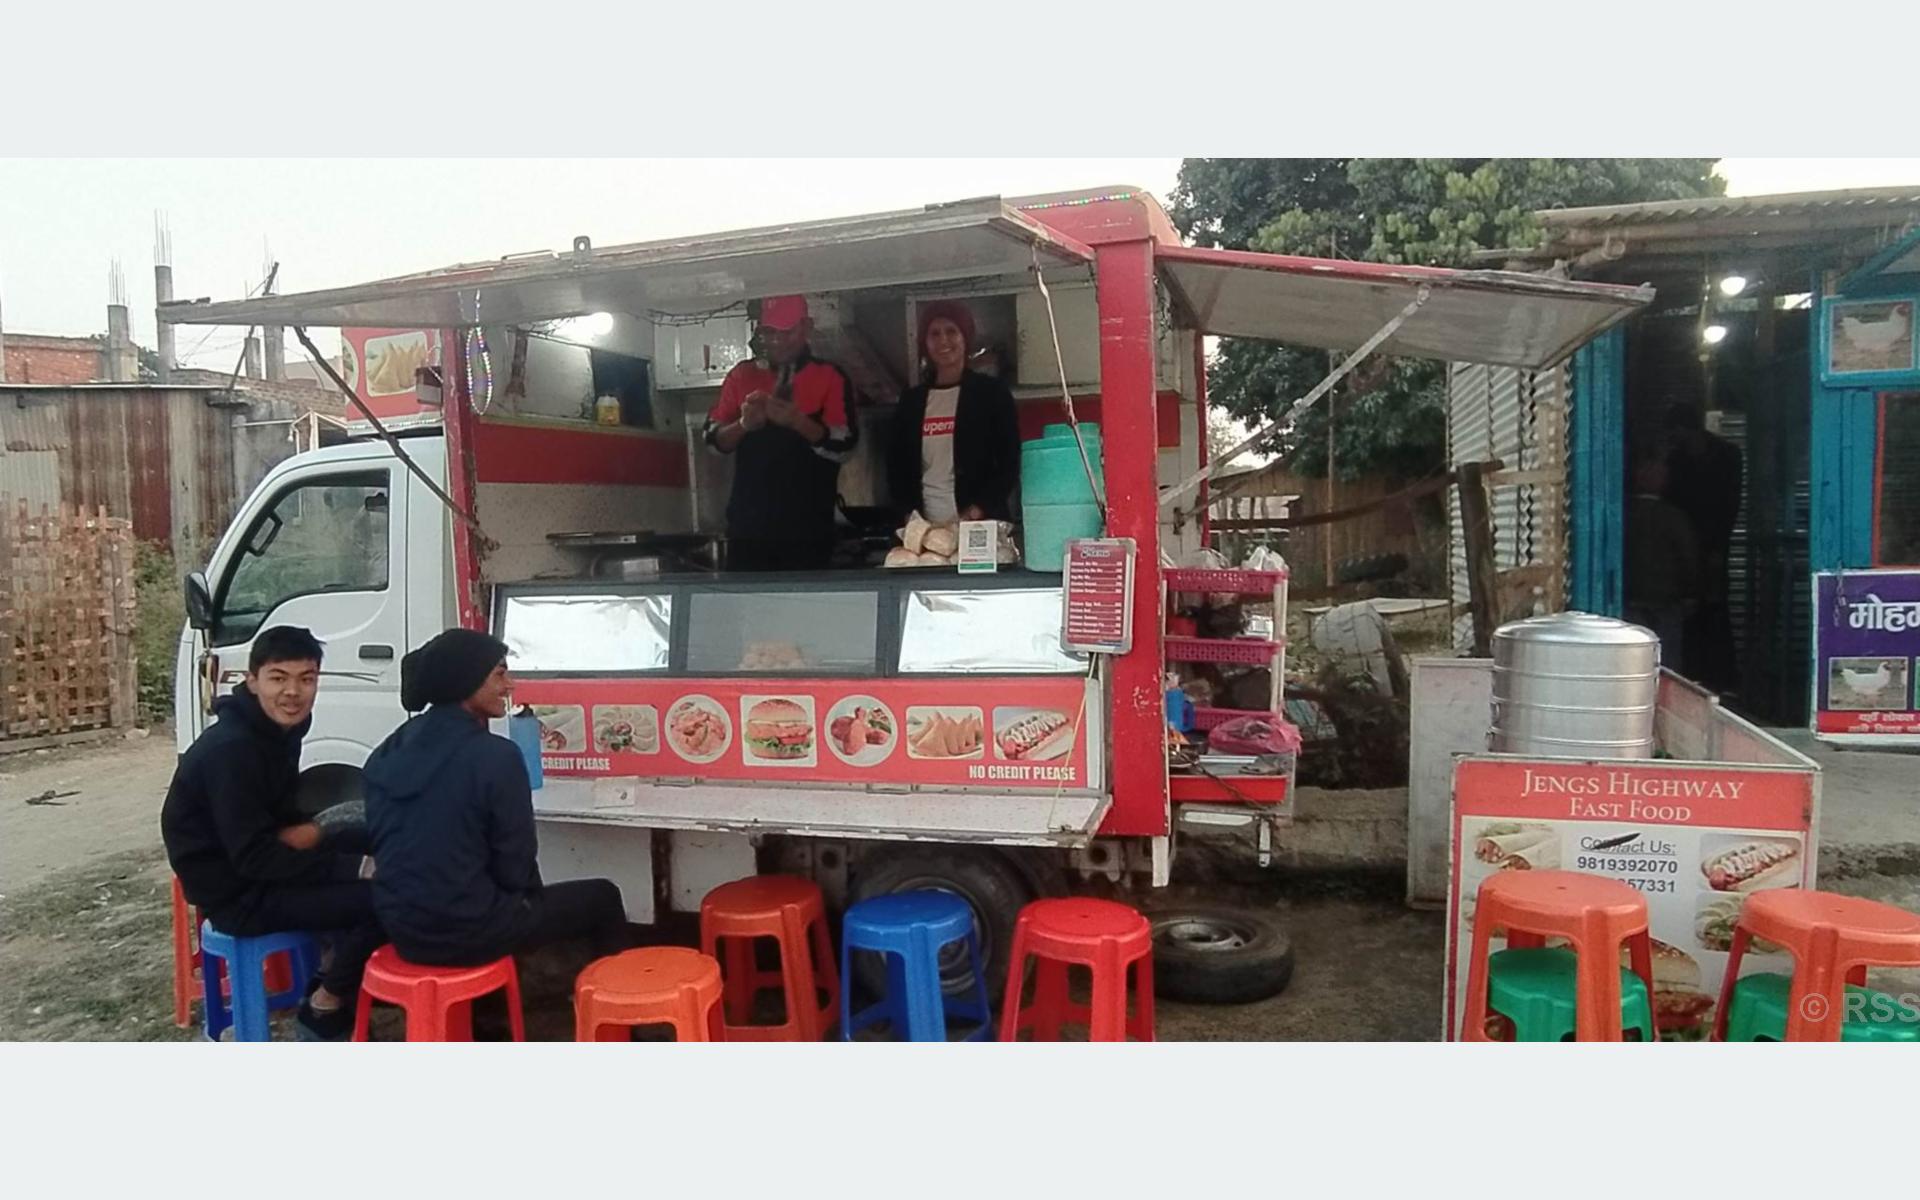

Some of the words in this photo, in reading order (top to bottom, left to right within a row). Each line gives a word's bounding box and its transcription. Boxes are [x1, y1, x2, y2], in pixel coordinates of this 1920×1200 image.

[541, 757, 574, 769] CREDIT
[576, 758, 610, 770] PLEASE
[969, 765, 985, 779] NO
[988, 766, 1031, 779] CREDIT
[1033, 766, 1076, 780] PLEASE
[1521, 769, 1600, 797] JENGS
[1608, 772, 1744, 799] HIGHWAY
[1569, 797, 1623, 817] FAST
[1630, 799, 1691, 821] FOOD
[1577, 856, 1678, 873] 9819392070
[1618, 878, 1675, 893] 57331
